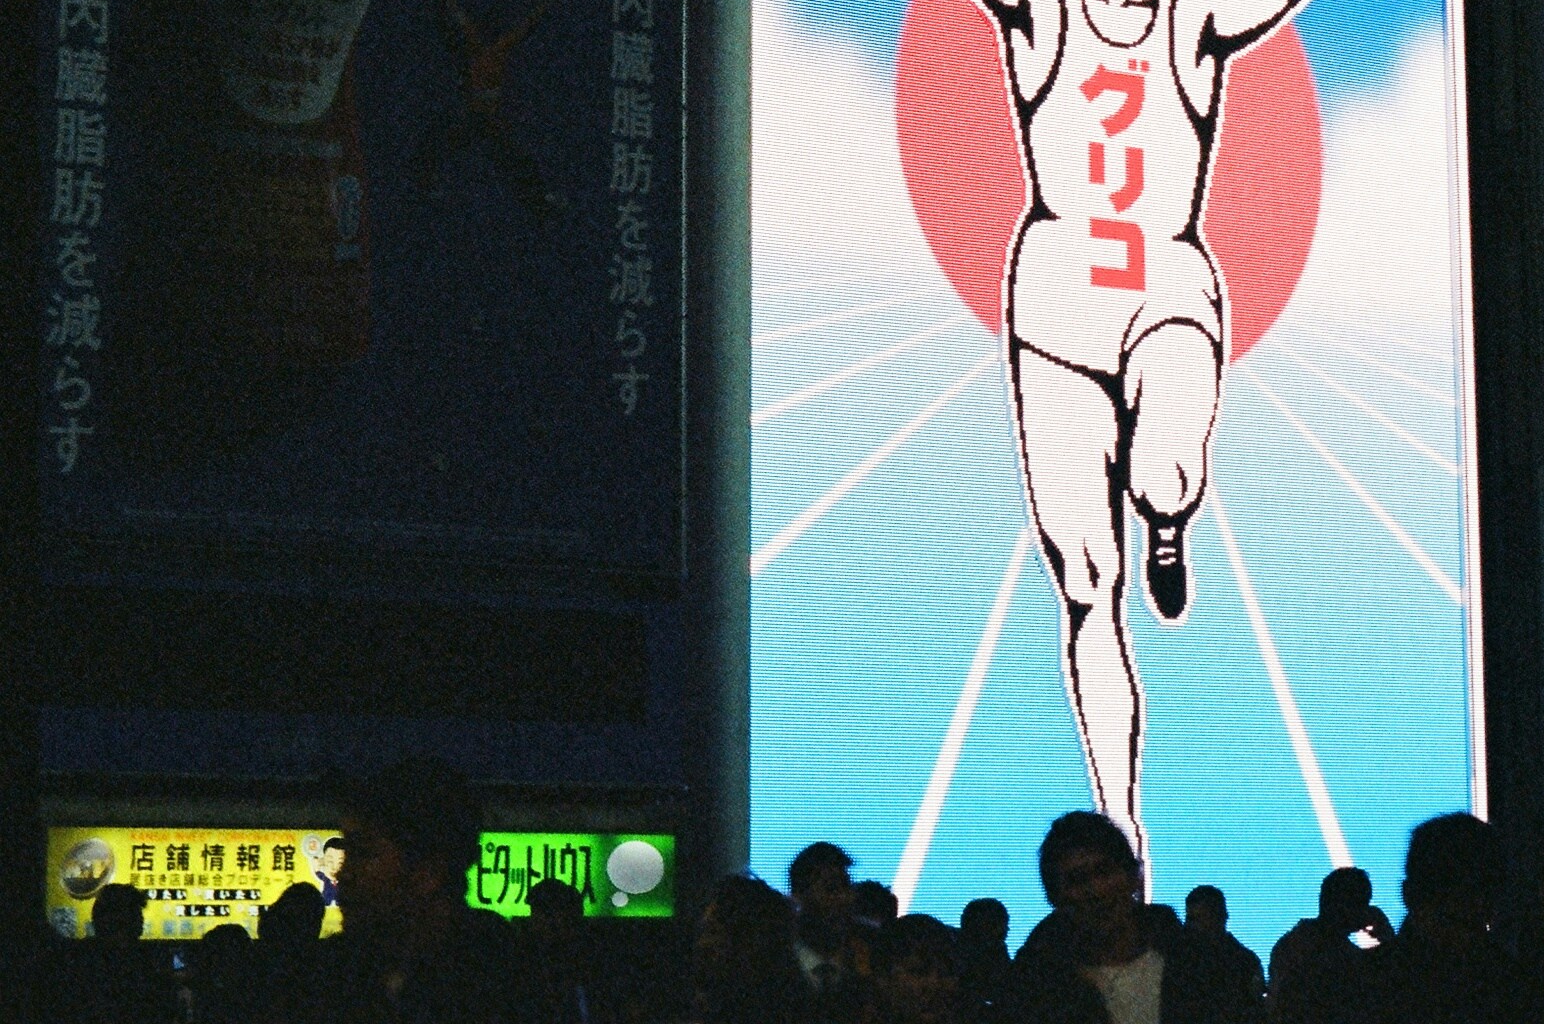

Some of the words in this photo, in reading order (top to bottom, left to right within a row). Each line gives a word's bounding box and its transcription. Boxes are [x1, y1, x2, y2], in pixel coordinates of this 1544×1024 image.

[1078, 58, 1147, 292] グリコ
[130, 843, 297, 872] 店舗情報館
